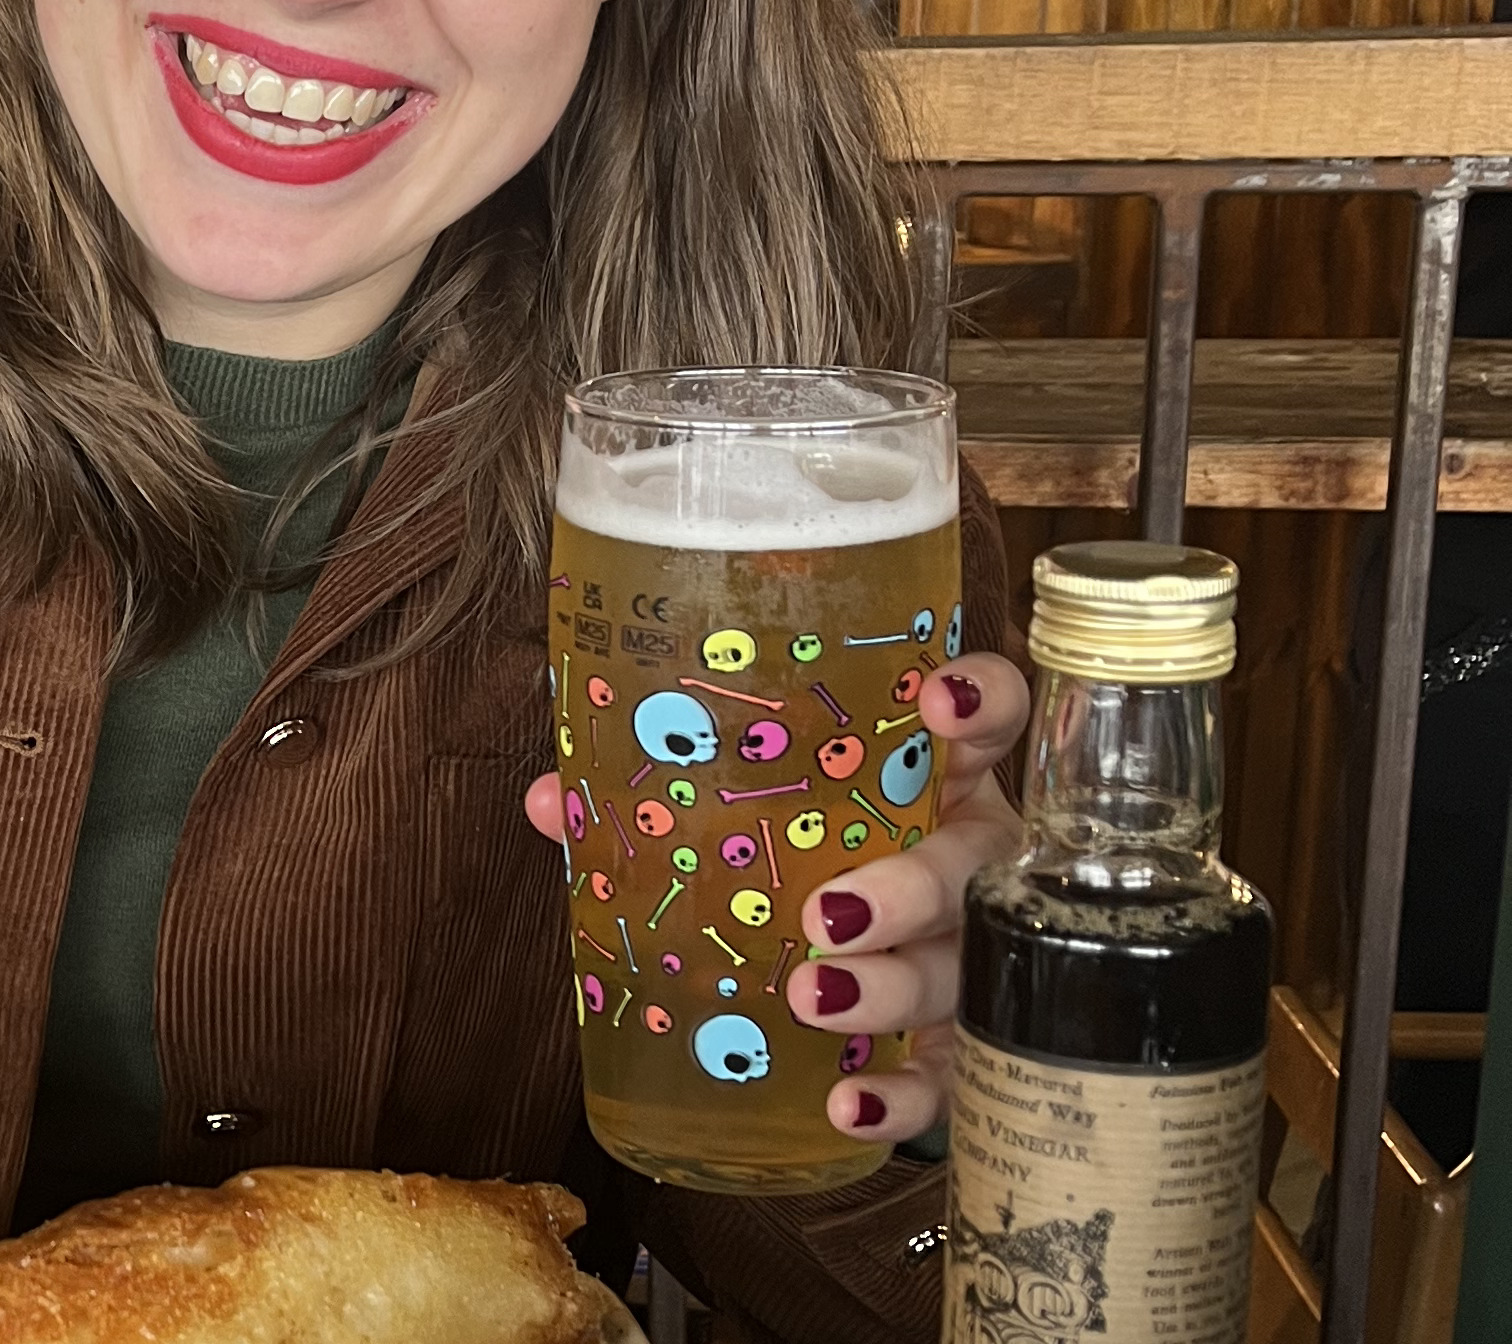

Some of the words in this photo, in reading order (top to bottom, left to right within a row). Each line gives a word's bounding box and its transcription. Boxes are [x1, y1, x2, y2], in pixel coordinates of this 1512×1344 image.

[626, 628, 675, 655] M25
[1046, 1099, 1098, 1130] Way
[985, 1114, 1092, 1164] VINEGAR
[1170, 1156, 1196, 1169] and
